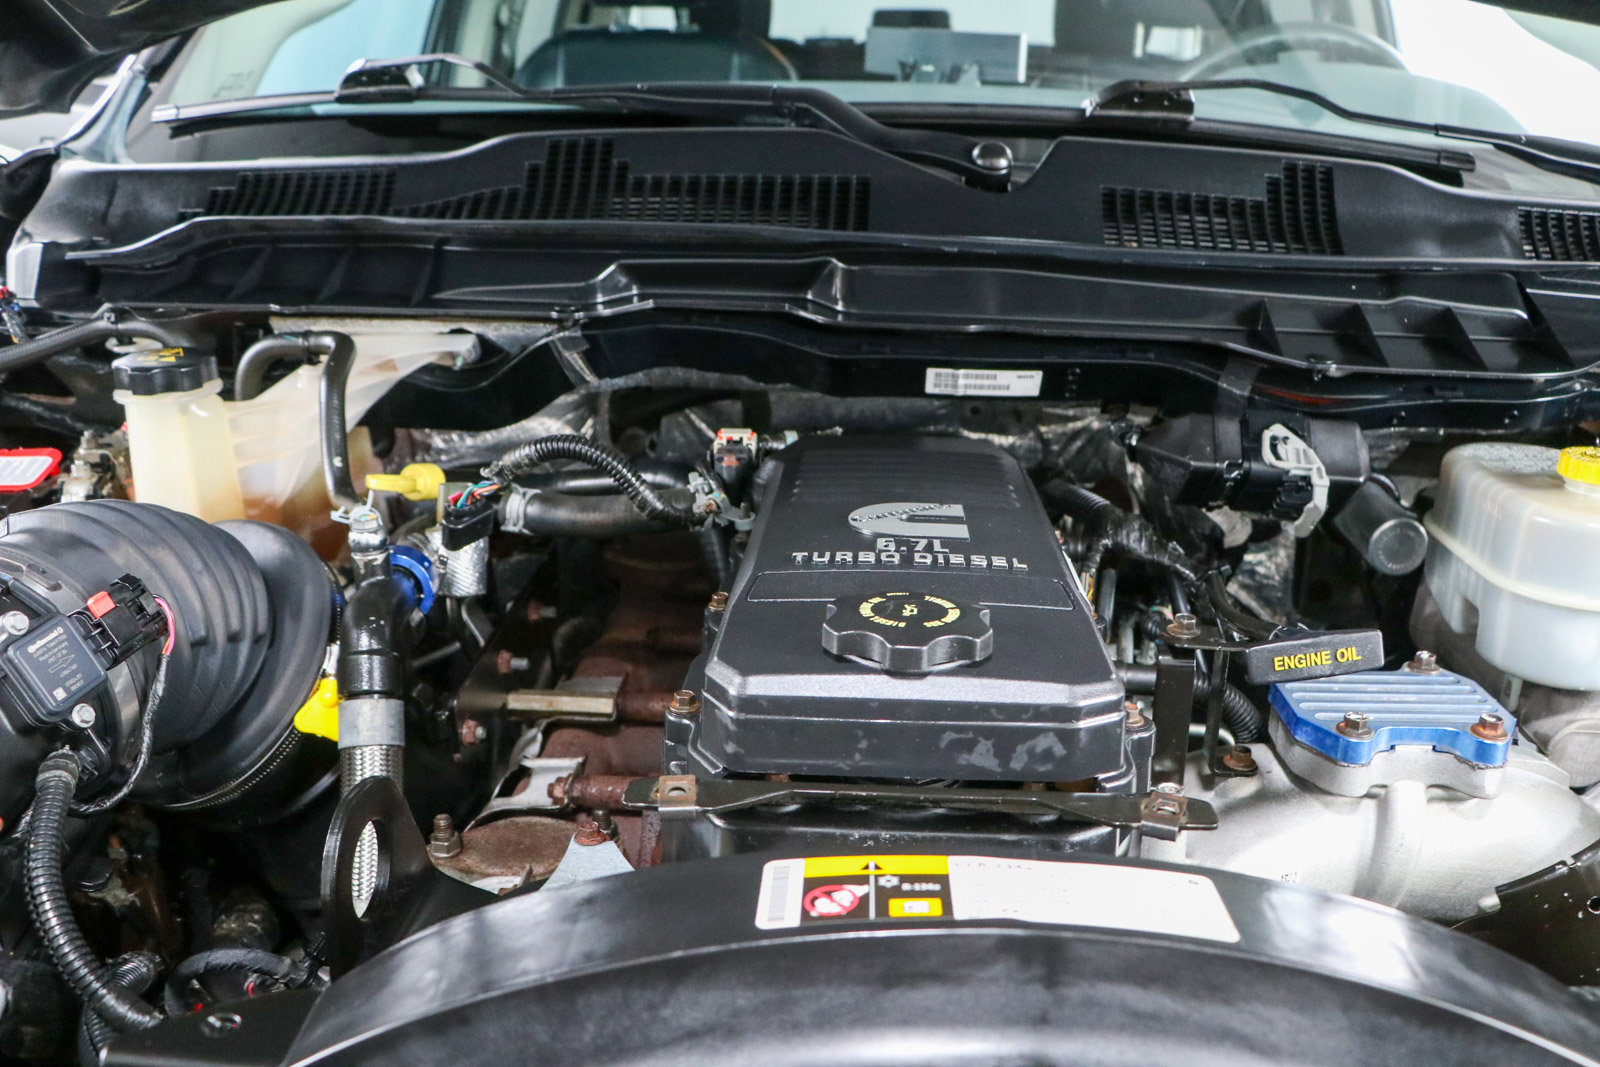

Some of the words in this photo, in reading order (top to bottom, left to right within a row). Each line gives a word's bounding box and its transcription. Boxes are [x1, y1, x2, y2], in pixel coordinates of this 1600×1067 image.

[792, 552, 900, 565] TURBO
[913, 552, 1028, 571] DIESEL
[1273, 651, 1331, 671] ENGINE
[1336, 646, 1361, 662] OIL
